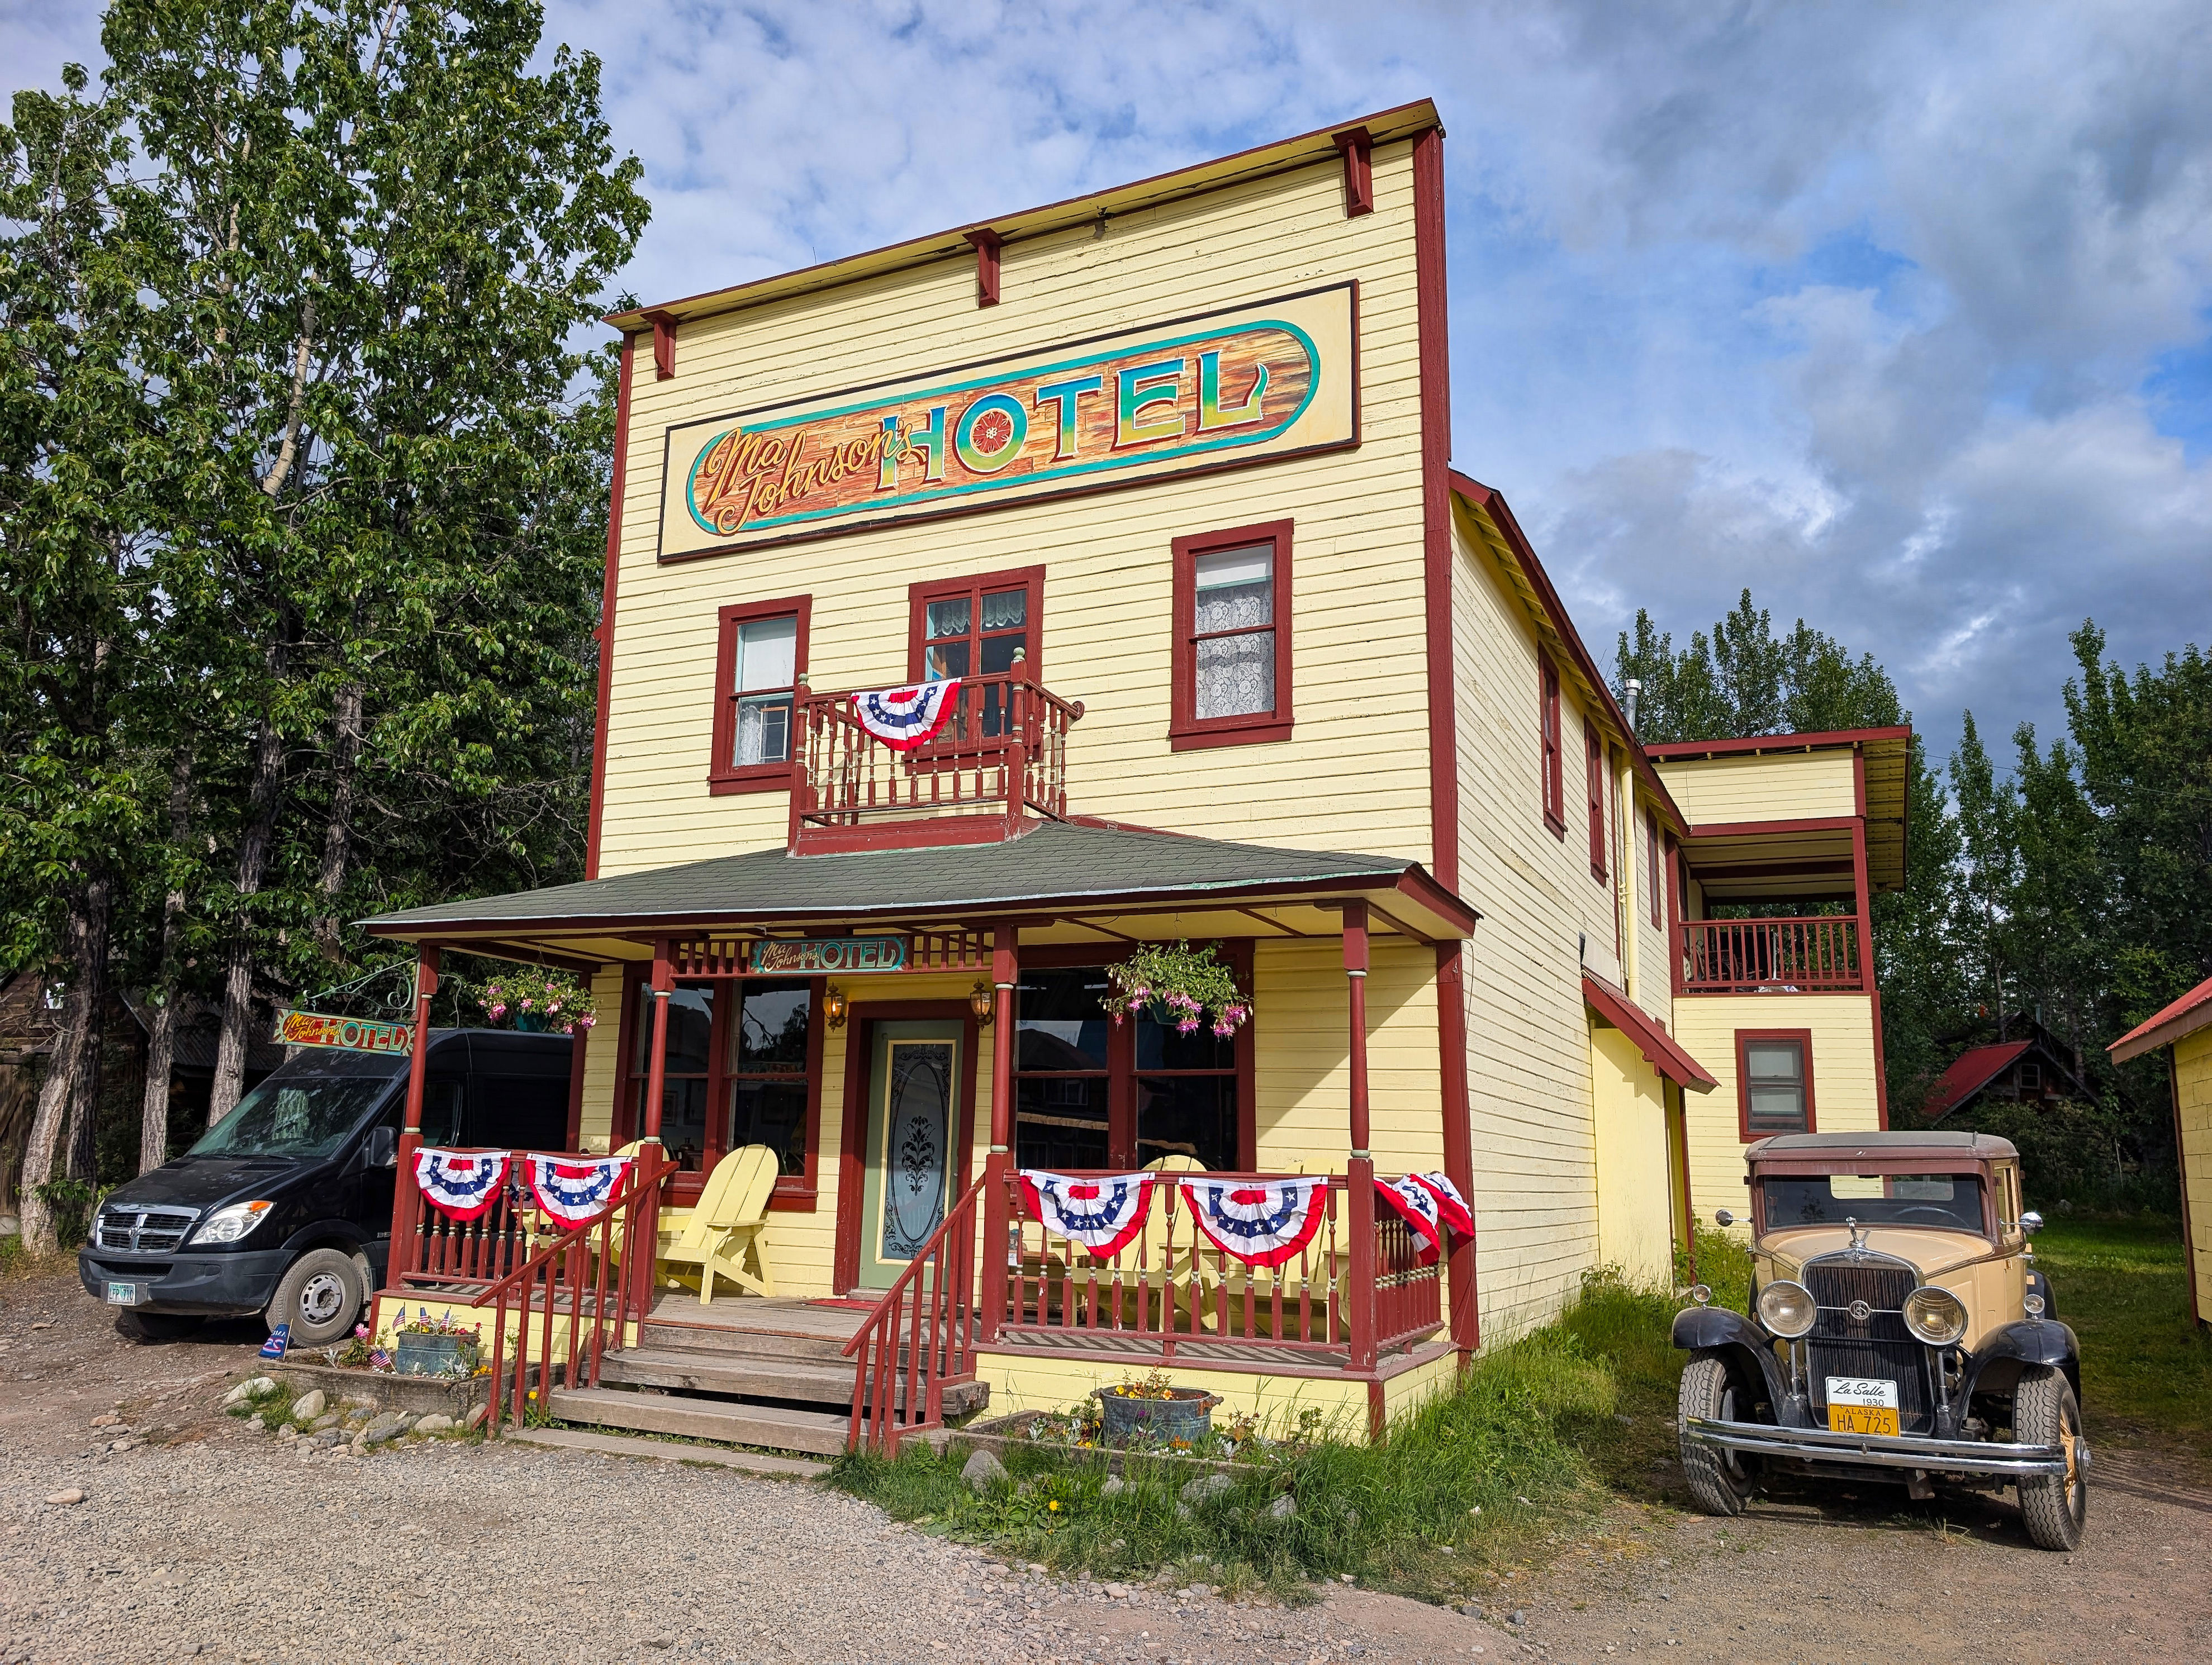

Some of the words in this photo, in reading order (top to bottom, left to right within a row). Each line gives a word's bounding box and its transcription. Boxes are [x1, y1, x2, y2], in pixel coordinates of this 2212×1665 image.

[877, 349, 1269, 490] HOTEL
[707, 427, 787, 506] Ma
[717, 420, 927, 535] Johnson's
[761, 941, 786, 965] Ma
[799, 941, 896, 969] HOTEL
[283, 1012, 310, 1034] Ma
[320, 1019, 404, 1051] HOTEL
[109, 1288, 120, 1301] LFP
[123, 1289, 134, 1301] 710
[1833, 1382, 1852, 1395] La
[1853, 1383, 1886, 1396] Salle
[1845, 1408, 1882, 1416] ALASKA
[1863, 1398, 1885, 1407] 1930
[1837, 1414, 1855, 1431] HA
[1863, 1416, 1891, 1434] 725
